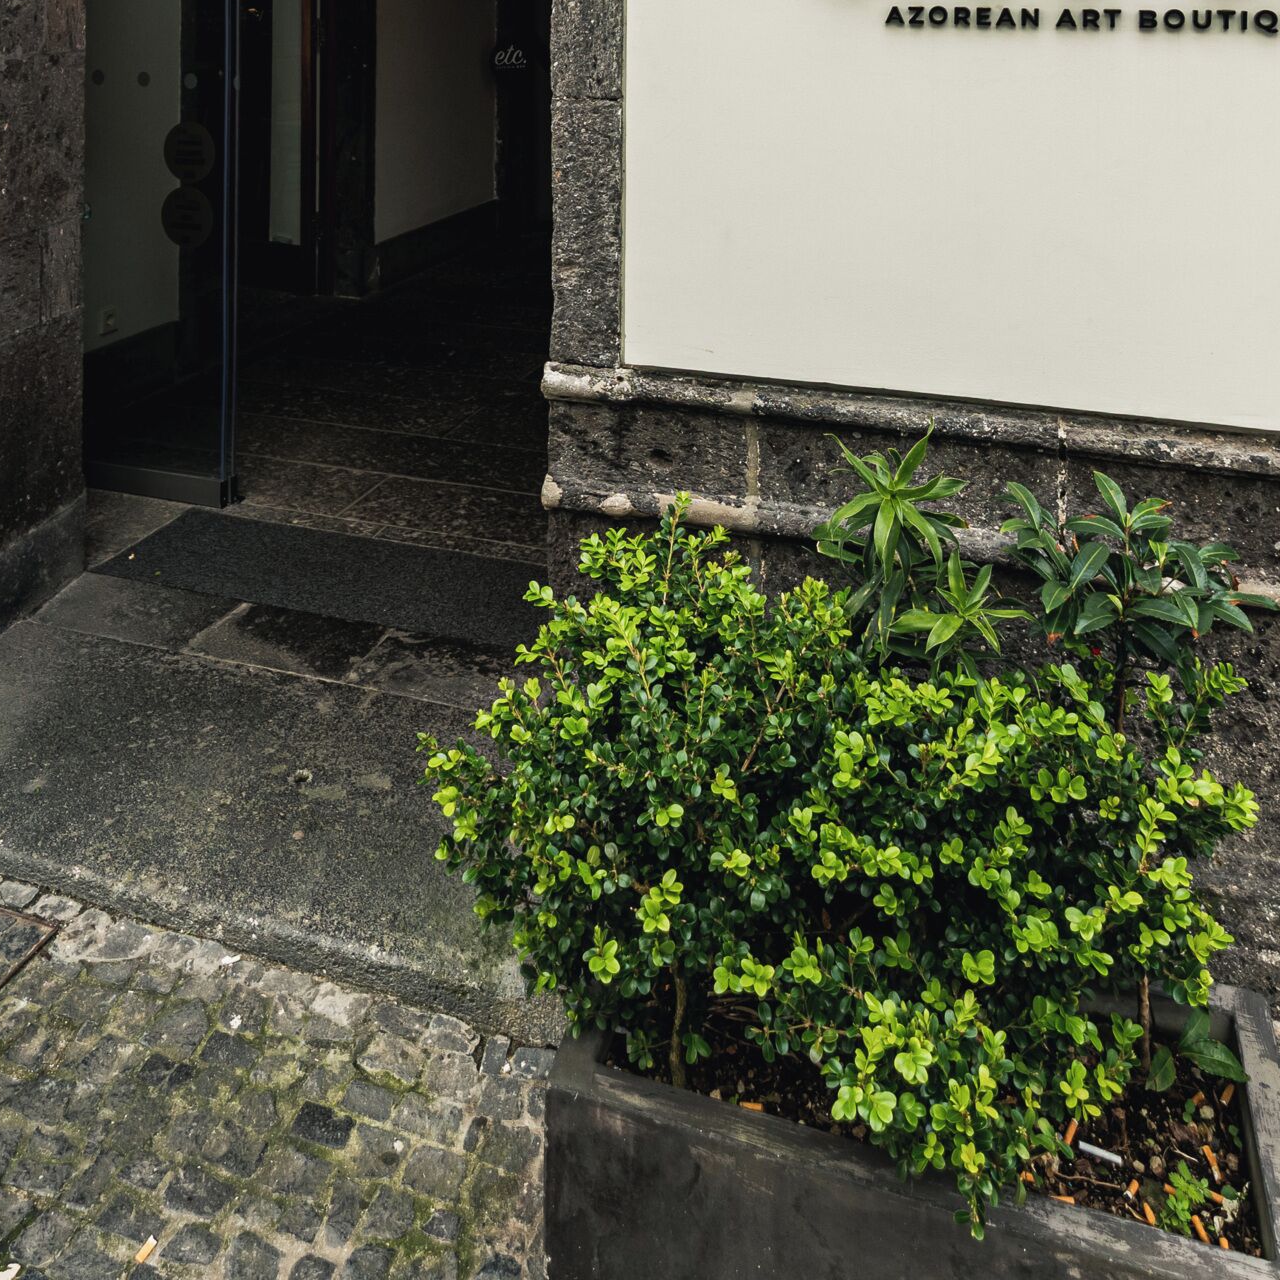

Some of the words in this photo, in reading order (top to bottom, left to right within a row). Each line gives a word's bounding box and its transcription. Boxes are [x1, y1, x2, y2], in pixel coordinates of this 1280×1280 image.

[885, 6, 1040, 28] AZOREAN
[1056, 8, 1122, 28] ART
[494, 45, 526, 65] etc.
